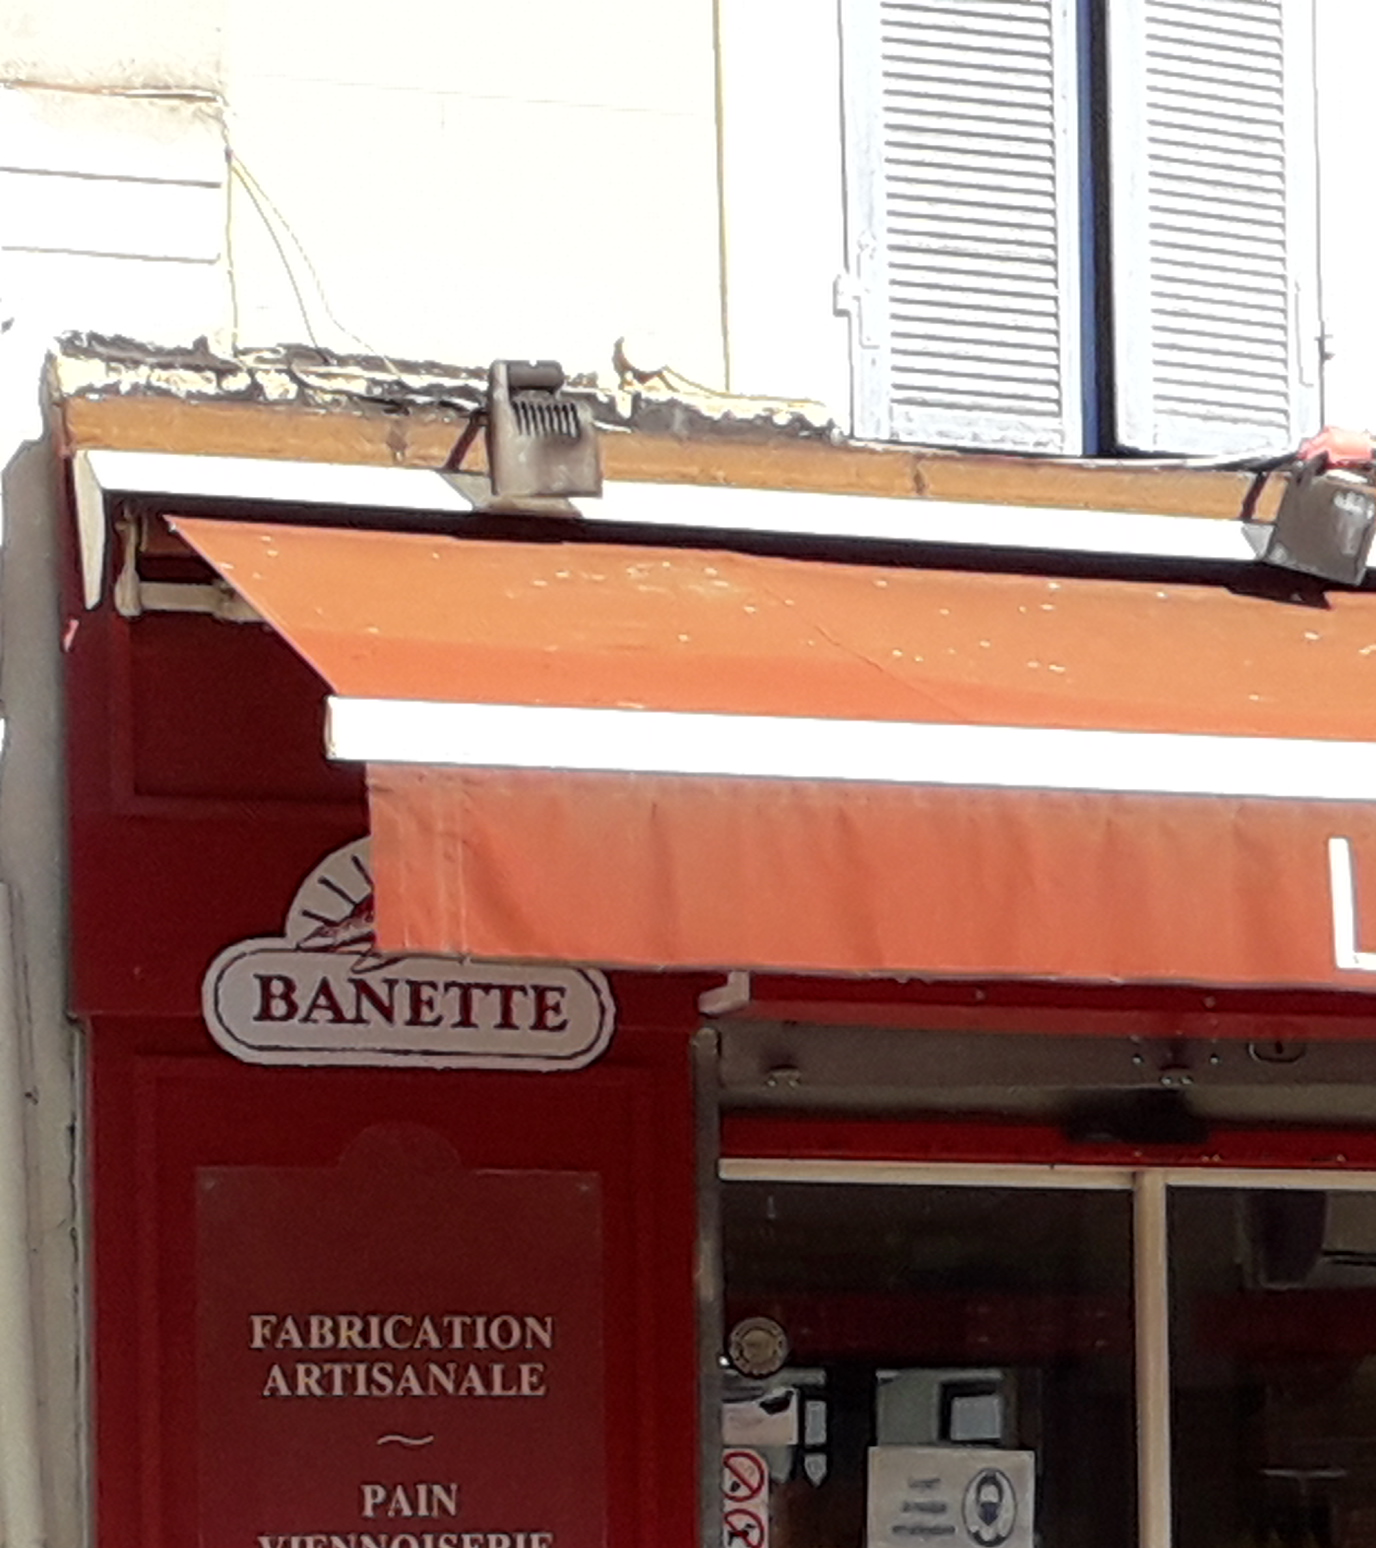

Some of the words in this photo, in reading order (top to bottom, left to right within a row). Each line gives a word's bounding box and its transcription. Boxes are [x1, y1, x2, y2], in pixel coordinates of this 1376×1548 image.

[252, 972, 569, 1032] BANETTE
[248, 1314, 555, 1351] FABRICATION
[262, 1362, 547, 1397] ARTISANALE
[361, 1482, 459, 1518] PAIN
